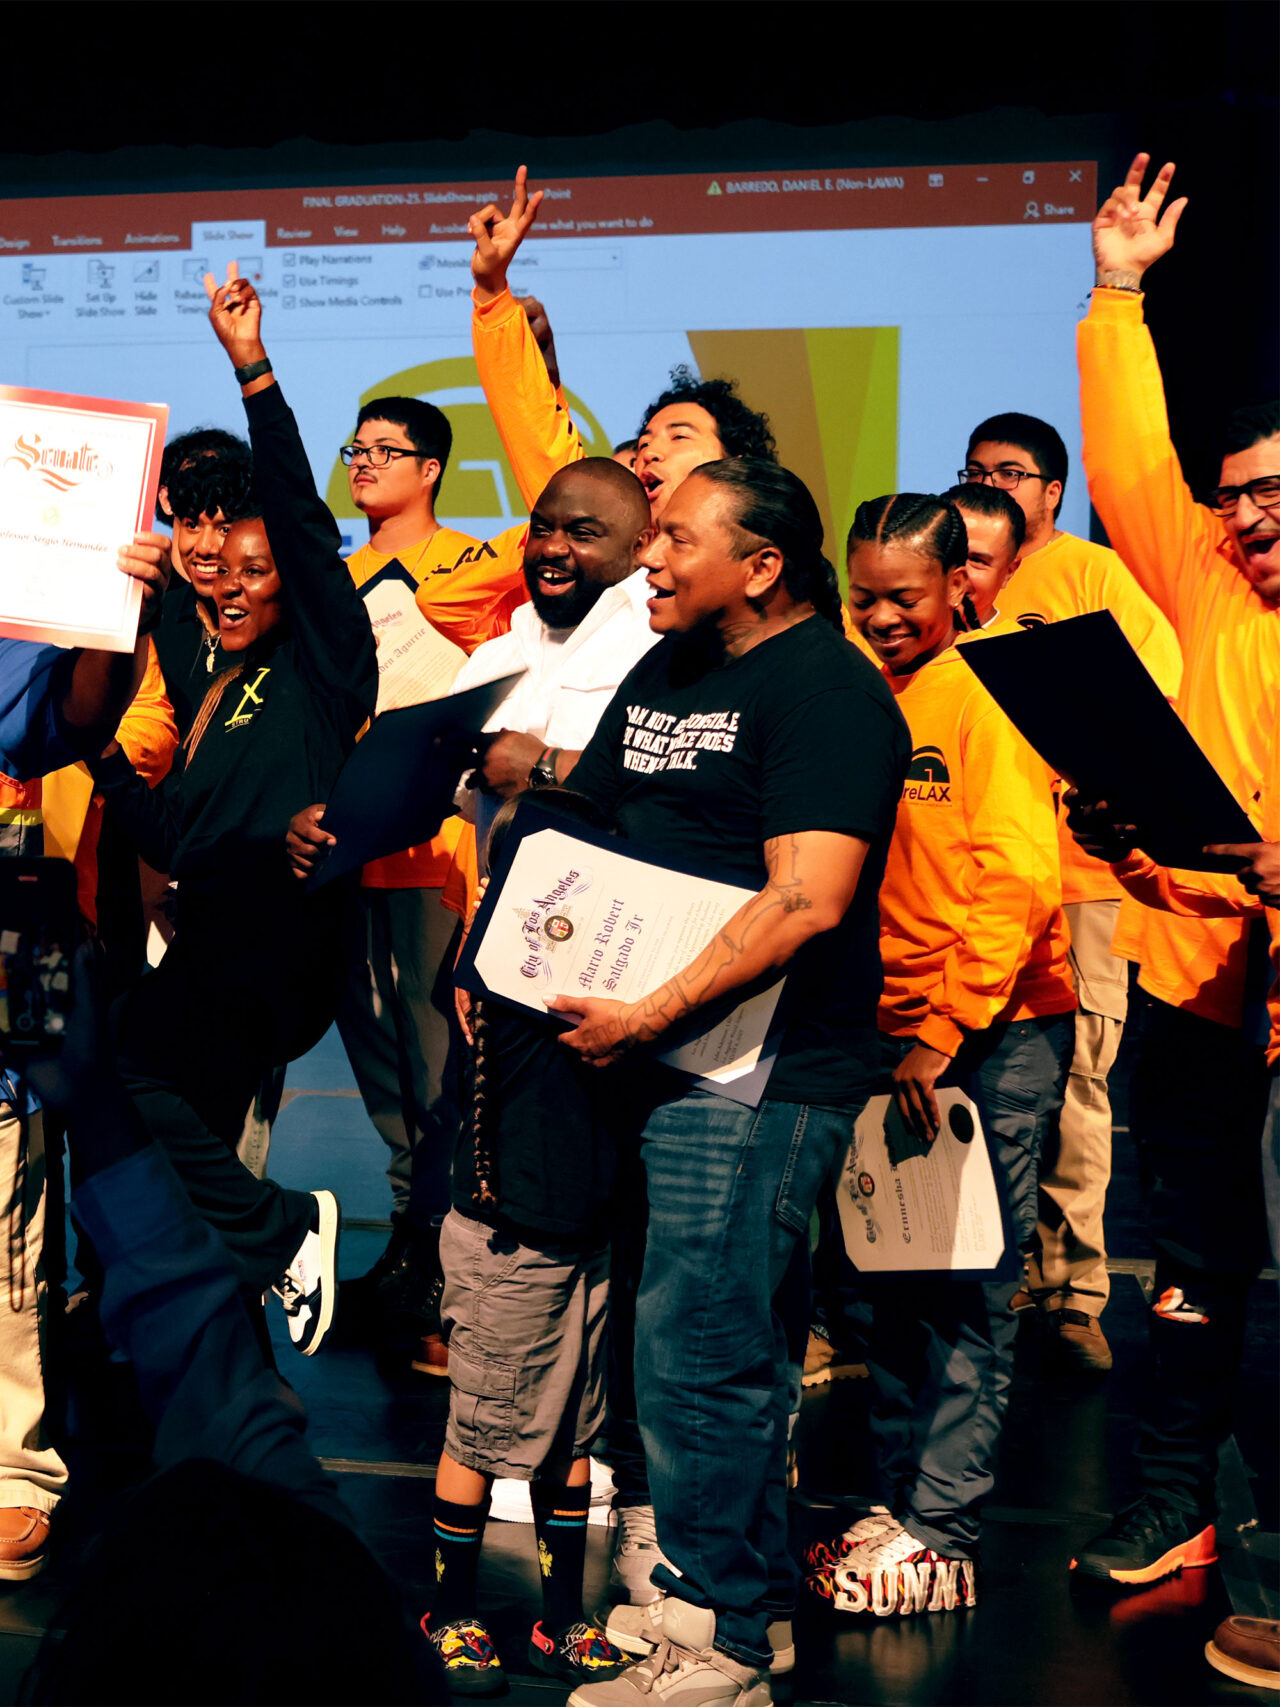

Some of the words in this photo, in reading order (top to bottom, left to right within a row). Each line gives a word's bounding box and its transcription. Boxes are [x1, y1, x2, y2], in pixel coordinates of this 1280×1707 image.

[782, 179, 823, 192] DANIEL
[302, 195, 333, 208] FINAL
[1044, 202, 1075, 215] Share
[549, 218, 575, 230] what
[576, 221, 597, 232] you
[598, 218, 624, 229] want
[625, 217, 637, 228] to
[639, 216, 654, 228] do
[52, 234, 103, 246] Transitions
[124, 232, 180, 244] Animations
[203, 230, 226, 241] Slide
[227, 229, 254, 241] Show
[277, 228, 312, 239] Review
[333, 226, 359, 237] View
[381, 223, 407, 237] Help
[299, 255, 320, 267] Play
[321, 254, 373, 265] Narrations
[319, 275, 360, 288] Timings
[2, 295, 40, 305] Custom
[42, 293, 65, 304] Slide
[85, 292, 101, 303] Set
[299, 297, 326, 308] Show
[328, 296, 359, 307] Media
[360, 294, 403, 306] Controls
[18, 309, 44, 319] Show
[100, 306, 126, 317] Show
[3, 432, 104, 475] Senate
[644, 710, 677, 734] NOT
[631, 728, 671, 755] WHAT
[695, 731, 736, 753] DOES
[623, 748, 660, 775] WHEN
[902, 784, 951, 802] reLAX
[532, 869, 580, 914] Angeles
[522, 911, 542, 935] Los
[525, 936, 541, 952] of
[578, 949, 604, 991] Mario
[594, 898, 625, 947] Robert
[520, 955, 543, 979] City
[602, 937, 635, 993] Salgado
